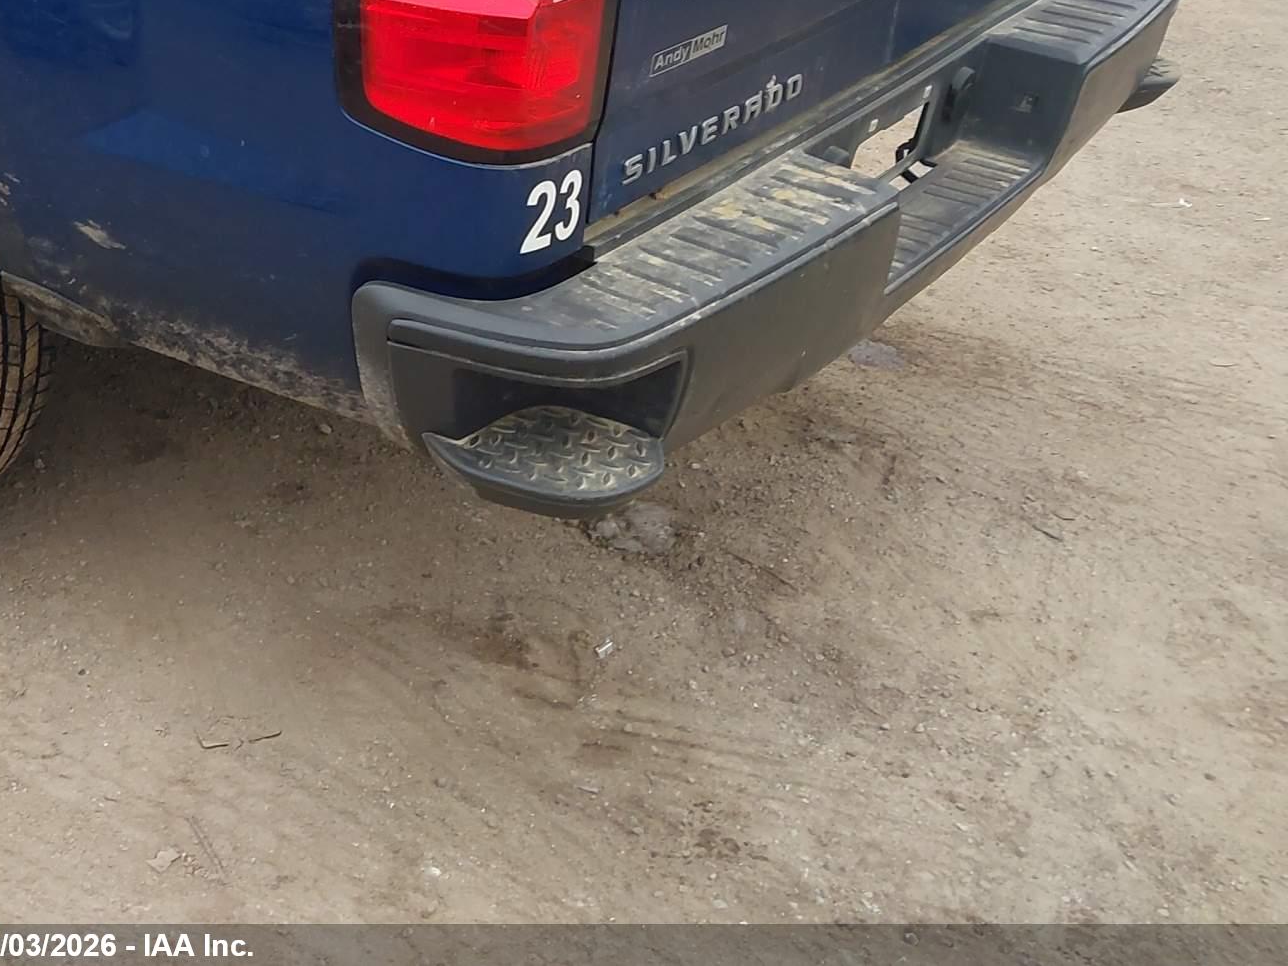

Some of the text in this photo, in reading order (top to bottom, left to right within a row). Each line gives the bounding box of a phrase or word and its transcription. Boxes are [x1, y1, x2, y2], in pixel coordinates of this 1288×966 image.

[654, 31, 725, 70] Andy Mohr
[622, 74, 802, 184] SILVERADO
[520, 169, 583, 254] 23
